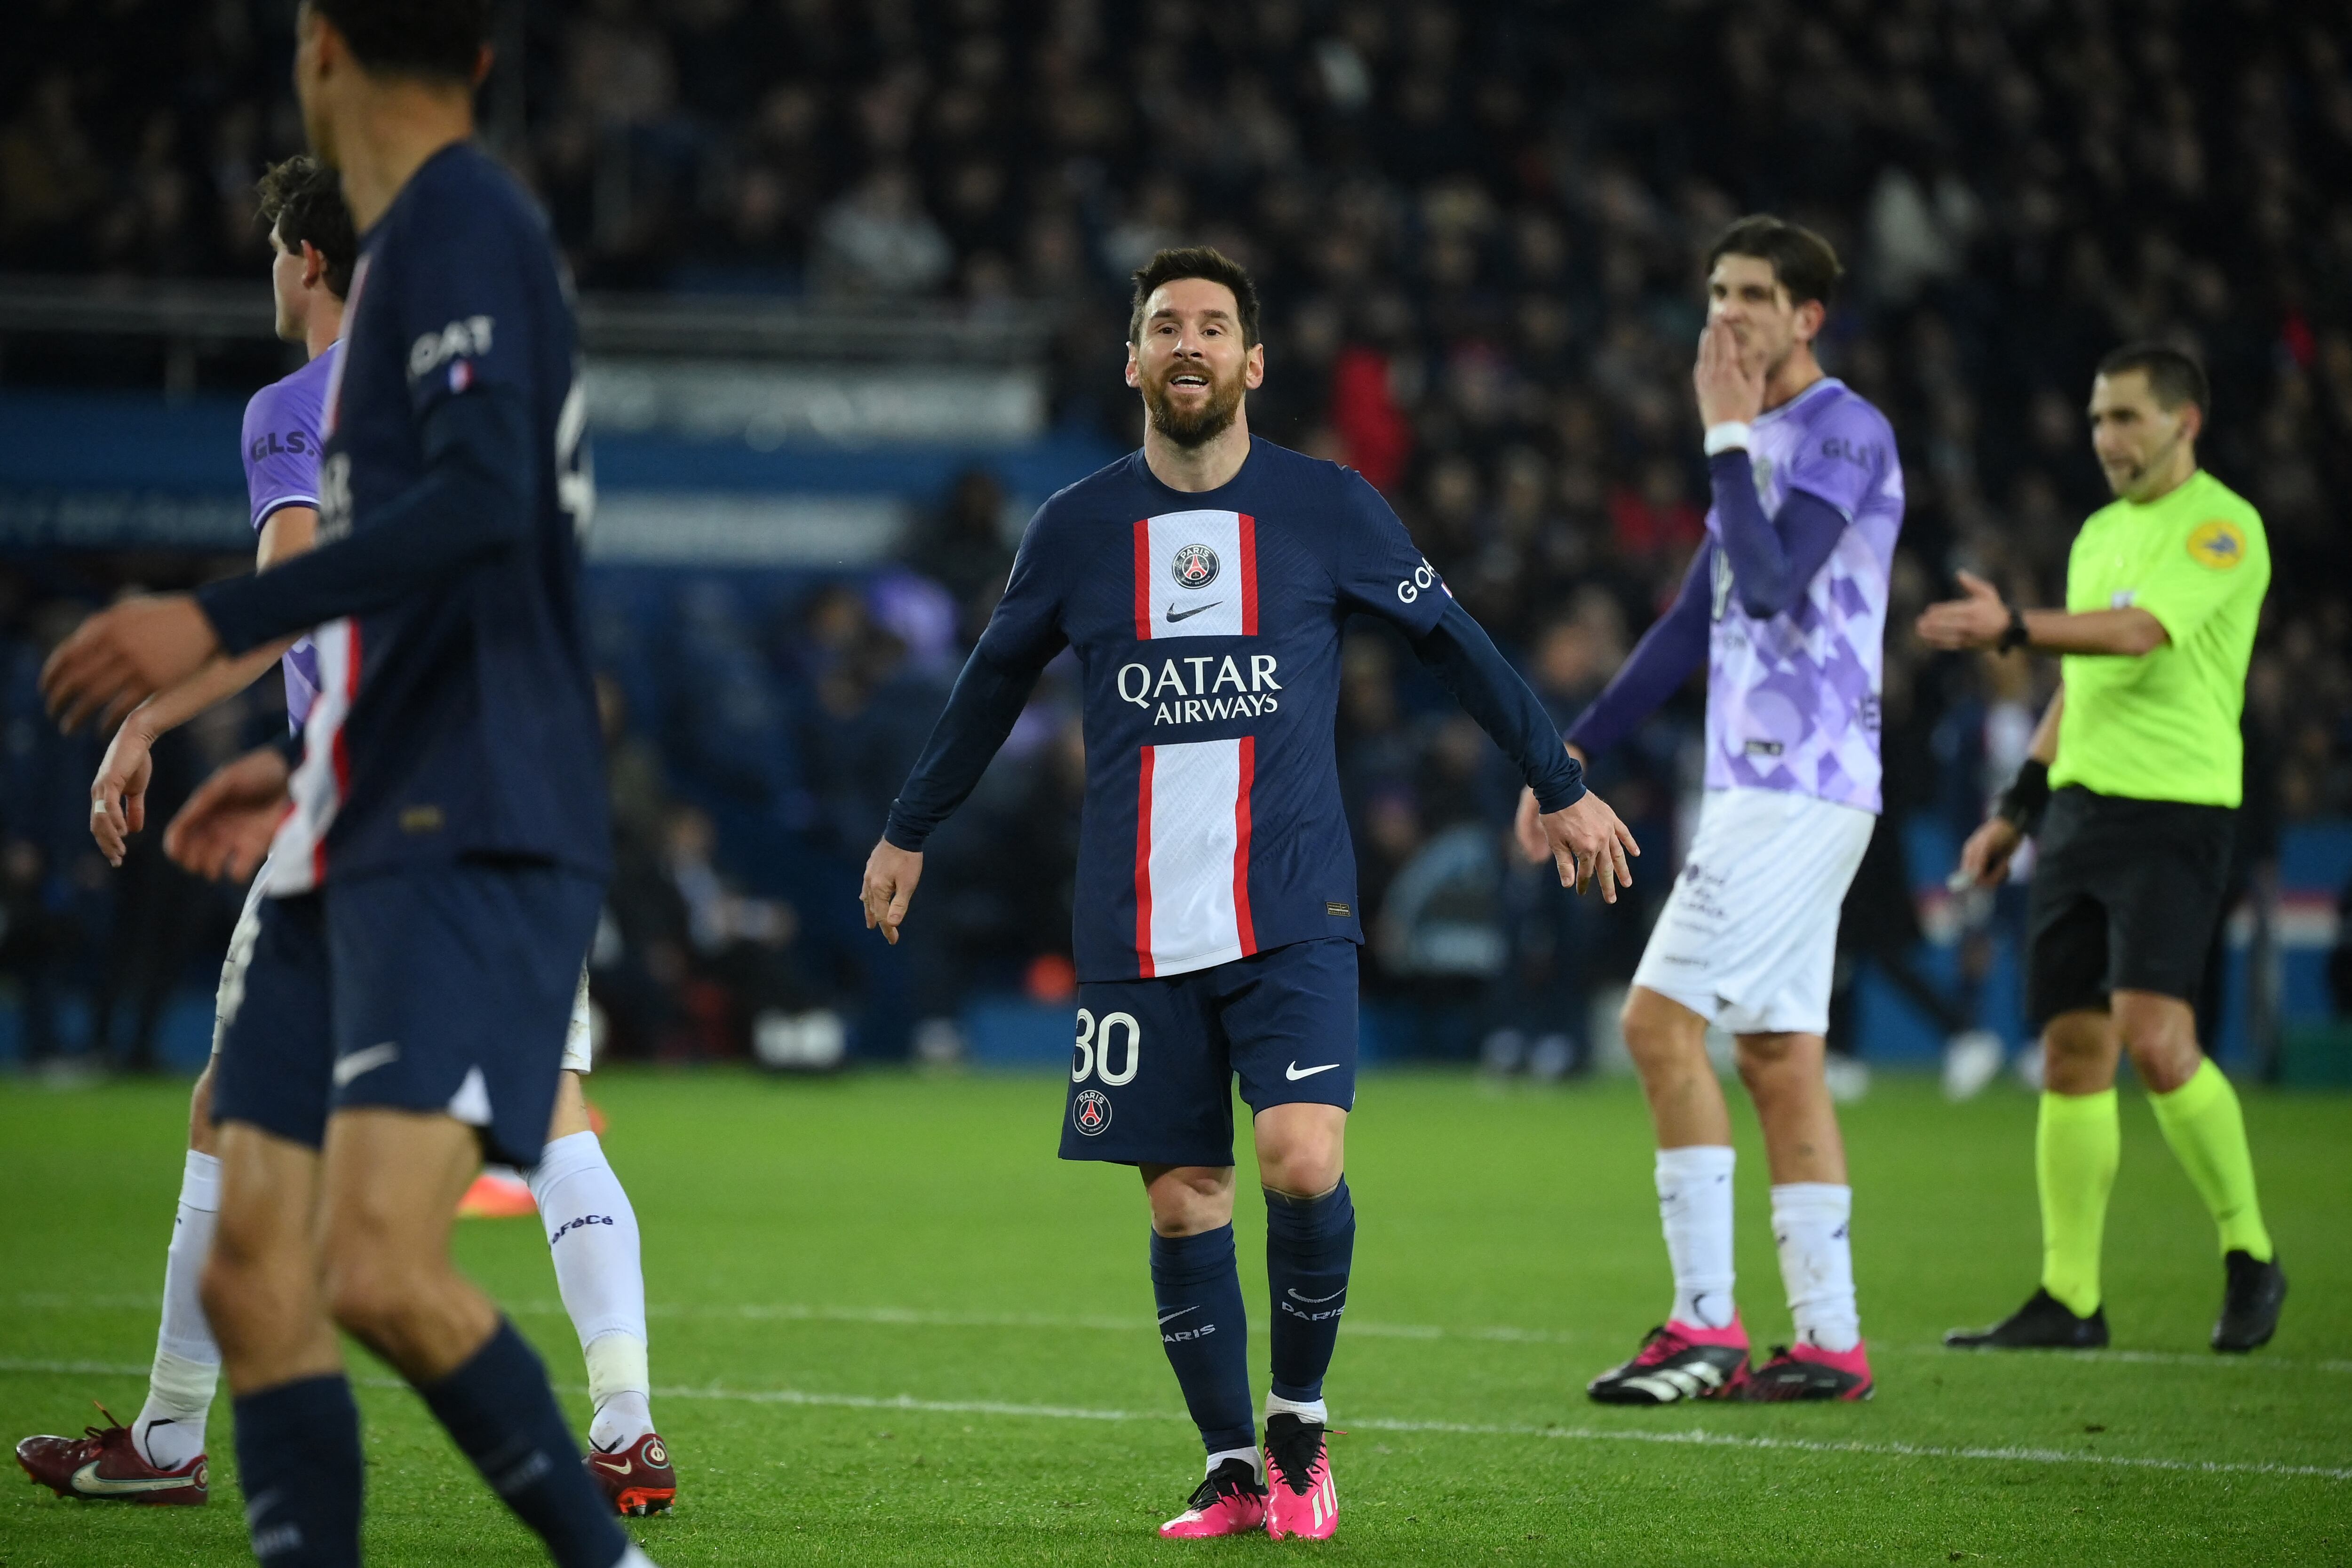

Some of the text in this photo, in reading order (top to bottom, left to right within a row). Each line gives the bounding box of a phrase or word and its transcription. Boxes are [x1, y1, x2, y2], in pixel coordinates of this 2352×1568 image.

[1180, 547, 1210, 559] PARIS
[1117, 655, 1283, 709] QATAR
[1154, 692, 1278, 725] AIRWAYS
[1072, 1008, 1140, 1086] 30
[1079, 1092, 1104, 1104] PARIS
